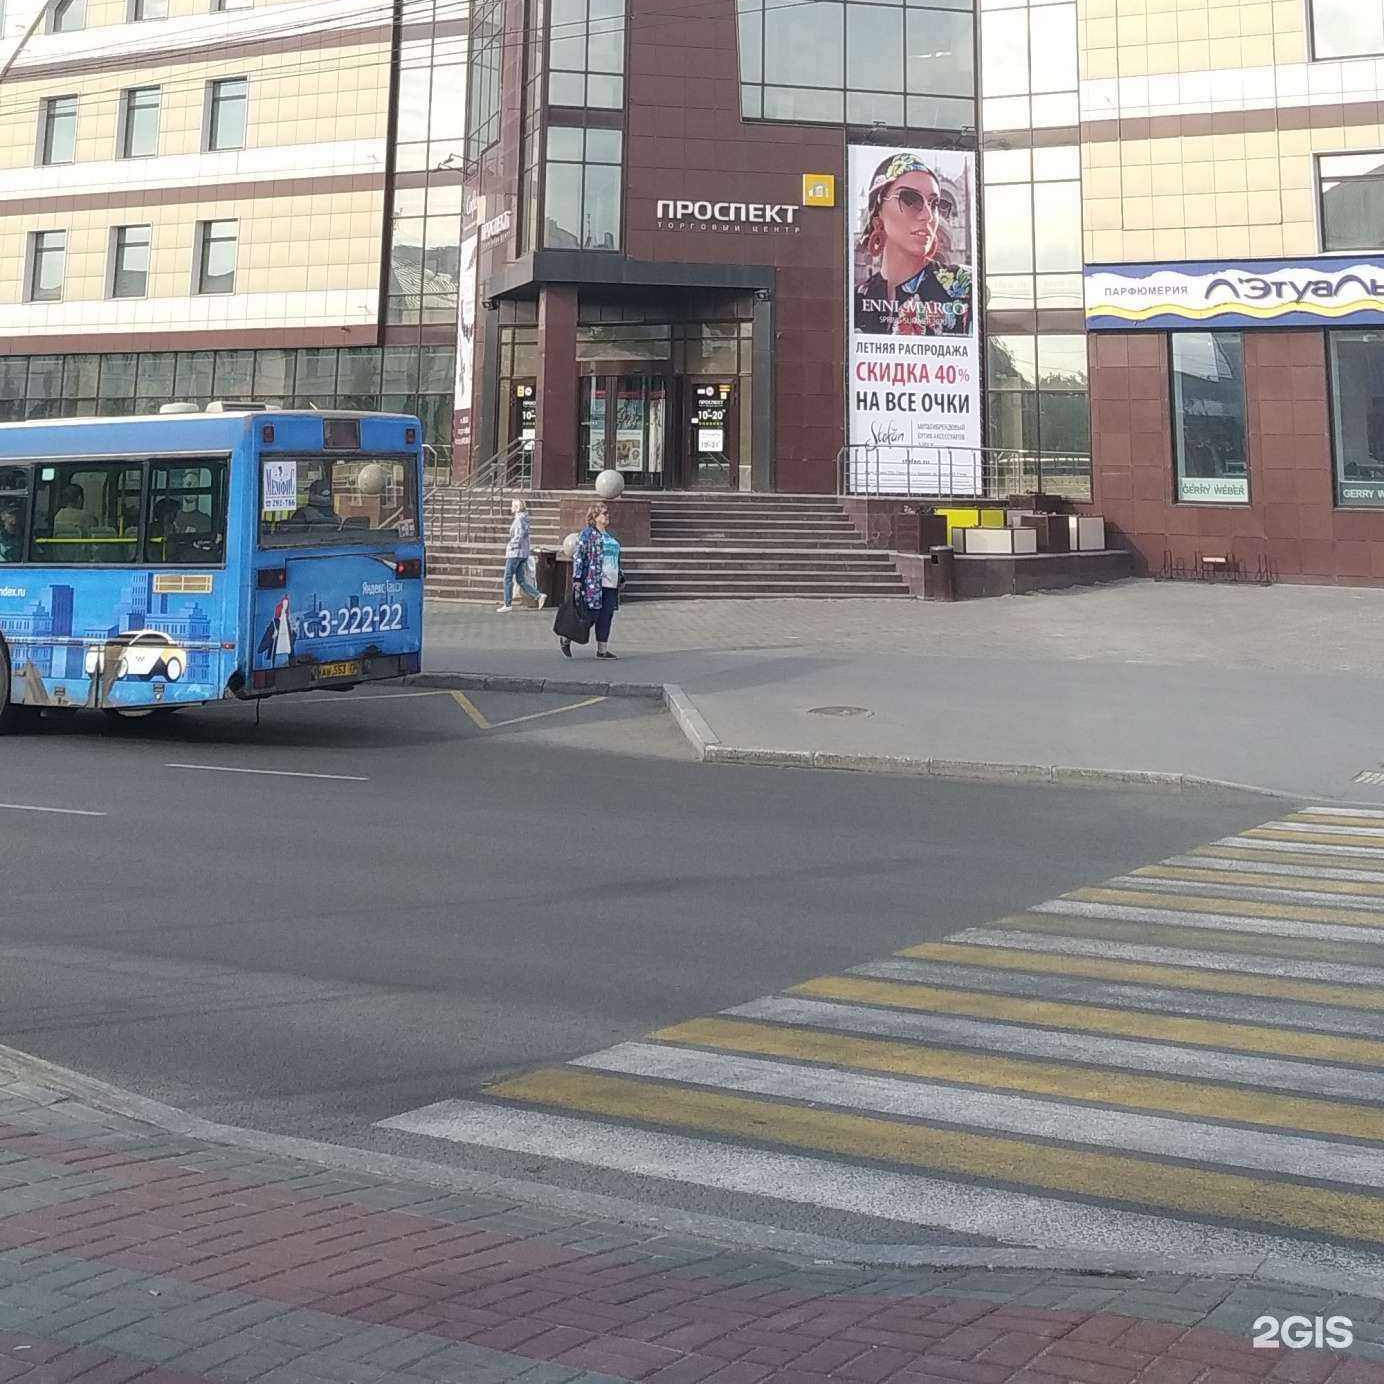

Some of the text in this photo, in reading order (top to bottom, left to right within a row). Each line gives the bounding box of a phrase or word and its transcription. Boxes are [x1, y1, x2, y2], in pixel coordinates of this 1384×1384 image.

[657, 200, 800, 224] ПРОСПЕКТ
[752, 226, 800, 234] ЦЕНТР
[1104, 286, 1188, 297] ПАРФЮМЕРИЯ
[862, 299, 965, 315] ENNI MARCO
[856, 342, 969, 358] ЛЕТНЯЯ РАСПРОДАЖА
[856, 361, 931, 387] СКИДКА
[856, 391, 970, 414] НА ВСЕ ОЧКИ
[865, 419, 905, 451] Stefan
[1182, 484, 1245, 496] GERRY WEBER
[1342, 489, 1375, 499] GERRY
